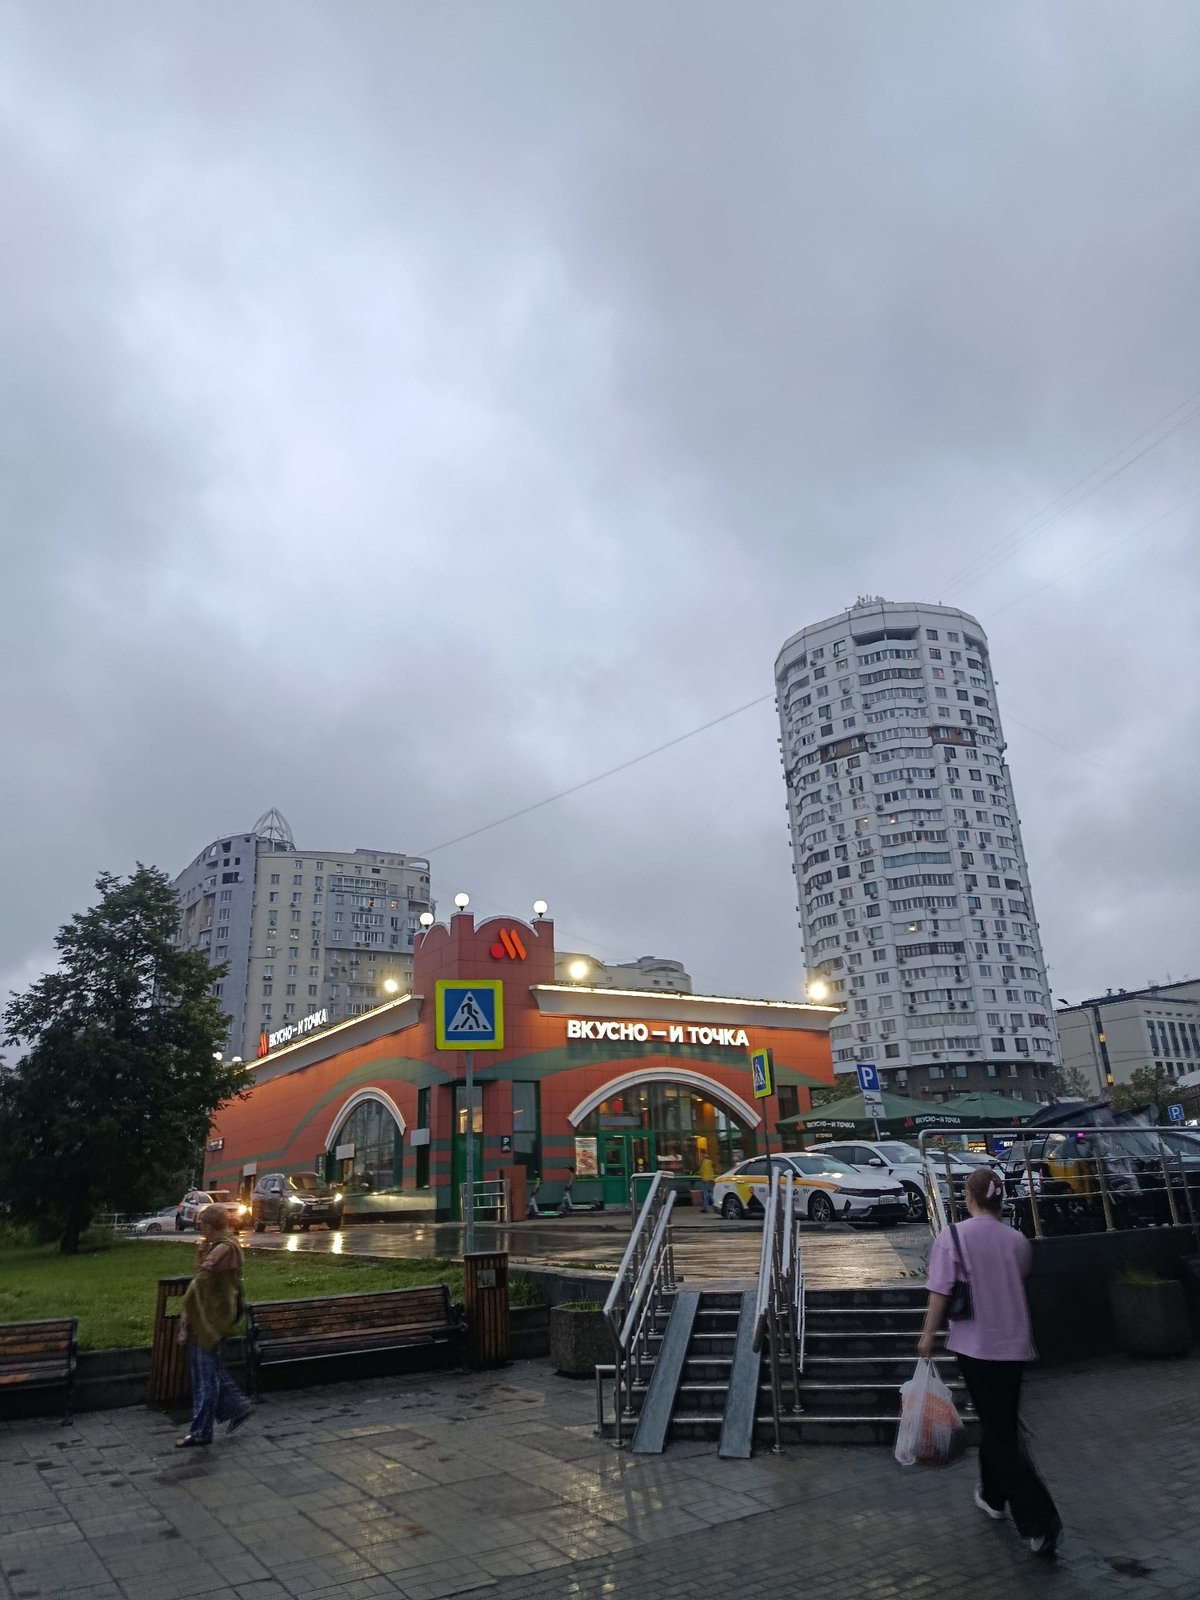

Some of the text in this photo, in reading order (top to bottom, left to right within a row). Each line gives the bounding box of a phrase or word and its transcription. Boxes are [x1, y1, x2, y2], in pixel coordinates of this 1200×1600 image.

[269, 1025, 292, 1047] ВКУСНО
[304, 1008, 328, 1031] ТОЧКА
[567, 1020, 648, 1041] ВКУСНО
[669, 1025, 684, 1043] И
[688, 1026, 749, 1046] ТОЧКА
[861, 1066, 873, 1088] P
